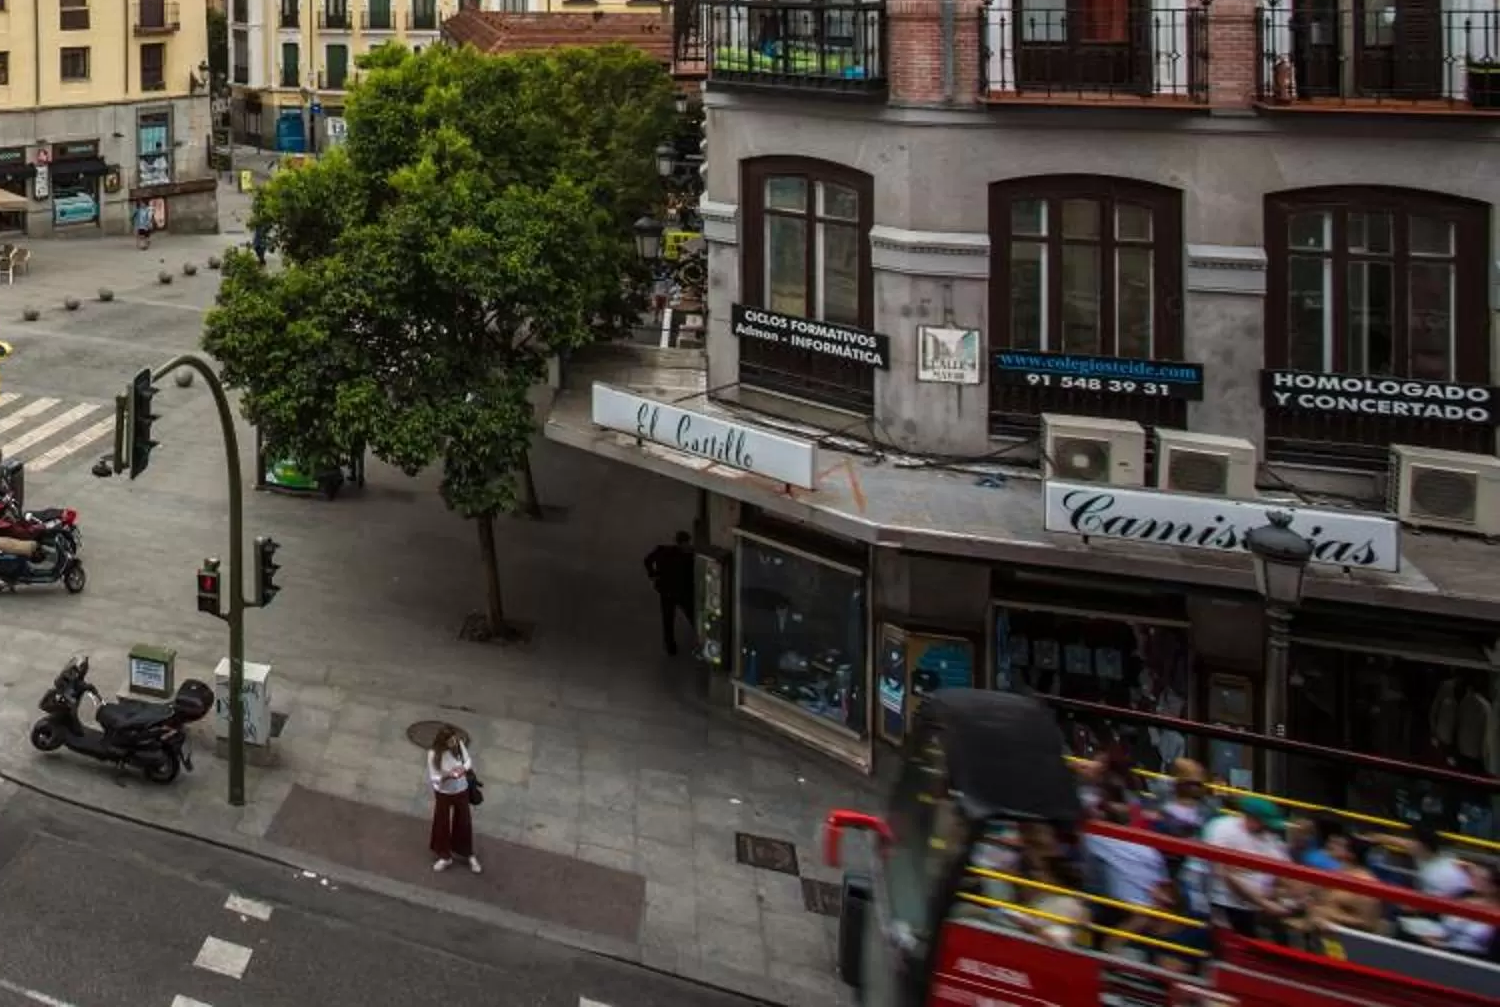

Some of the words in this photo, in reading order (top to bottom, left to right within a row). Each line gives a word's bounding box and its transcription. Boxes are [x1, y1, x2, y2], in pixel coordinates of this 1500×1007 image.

[735, 323, 779, 341] Admon
[744, 310, 788, 328] CICLOS
[790, 320, 877, 348] FORMATIVOS
[1026, 373, 1050, 386] 91
[1060, 376, 1101, 390] 548
[1108, 379, 1136, 393] 39
[1143, 382, 1169, 396] 31
[1273, 372, 1490, 402] HOMOLOGADO
[1273, 391, 1291, 406] Y
[1297, 393, 1489, 422] CONCERTADO
[636, 402, 660, 441] El
[676, 414, 754, 468] Castillo
